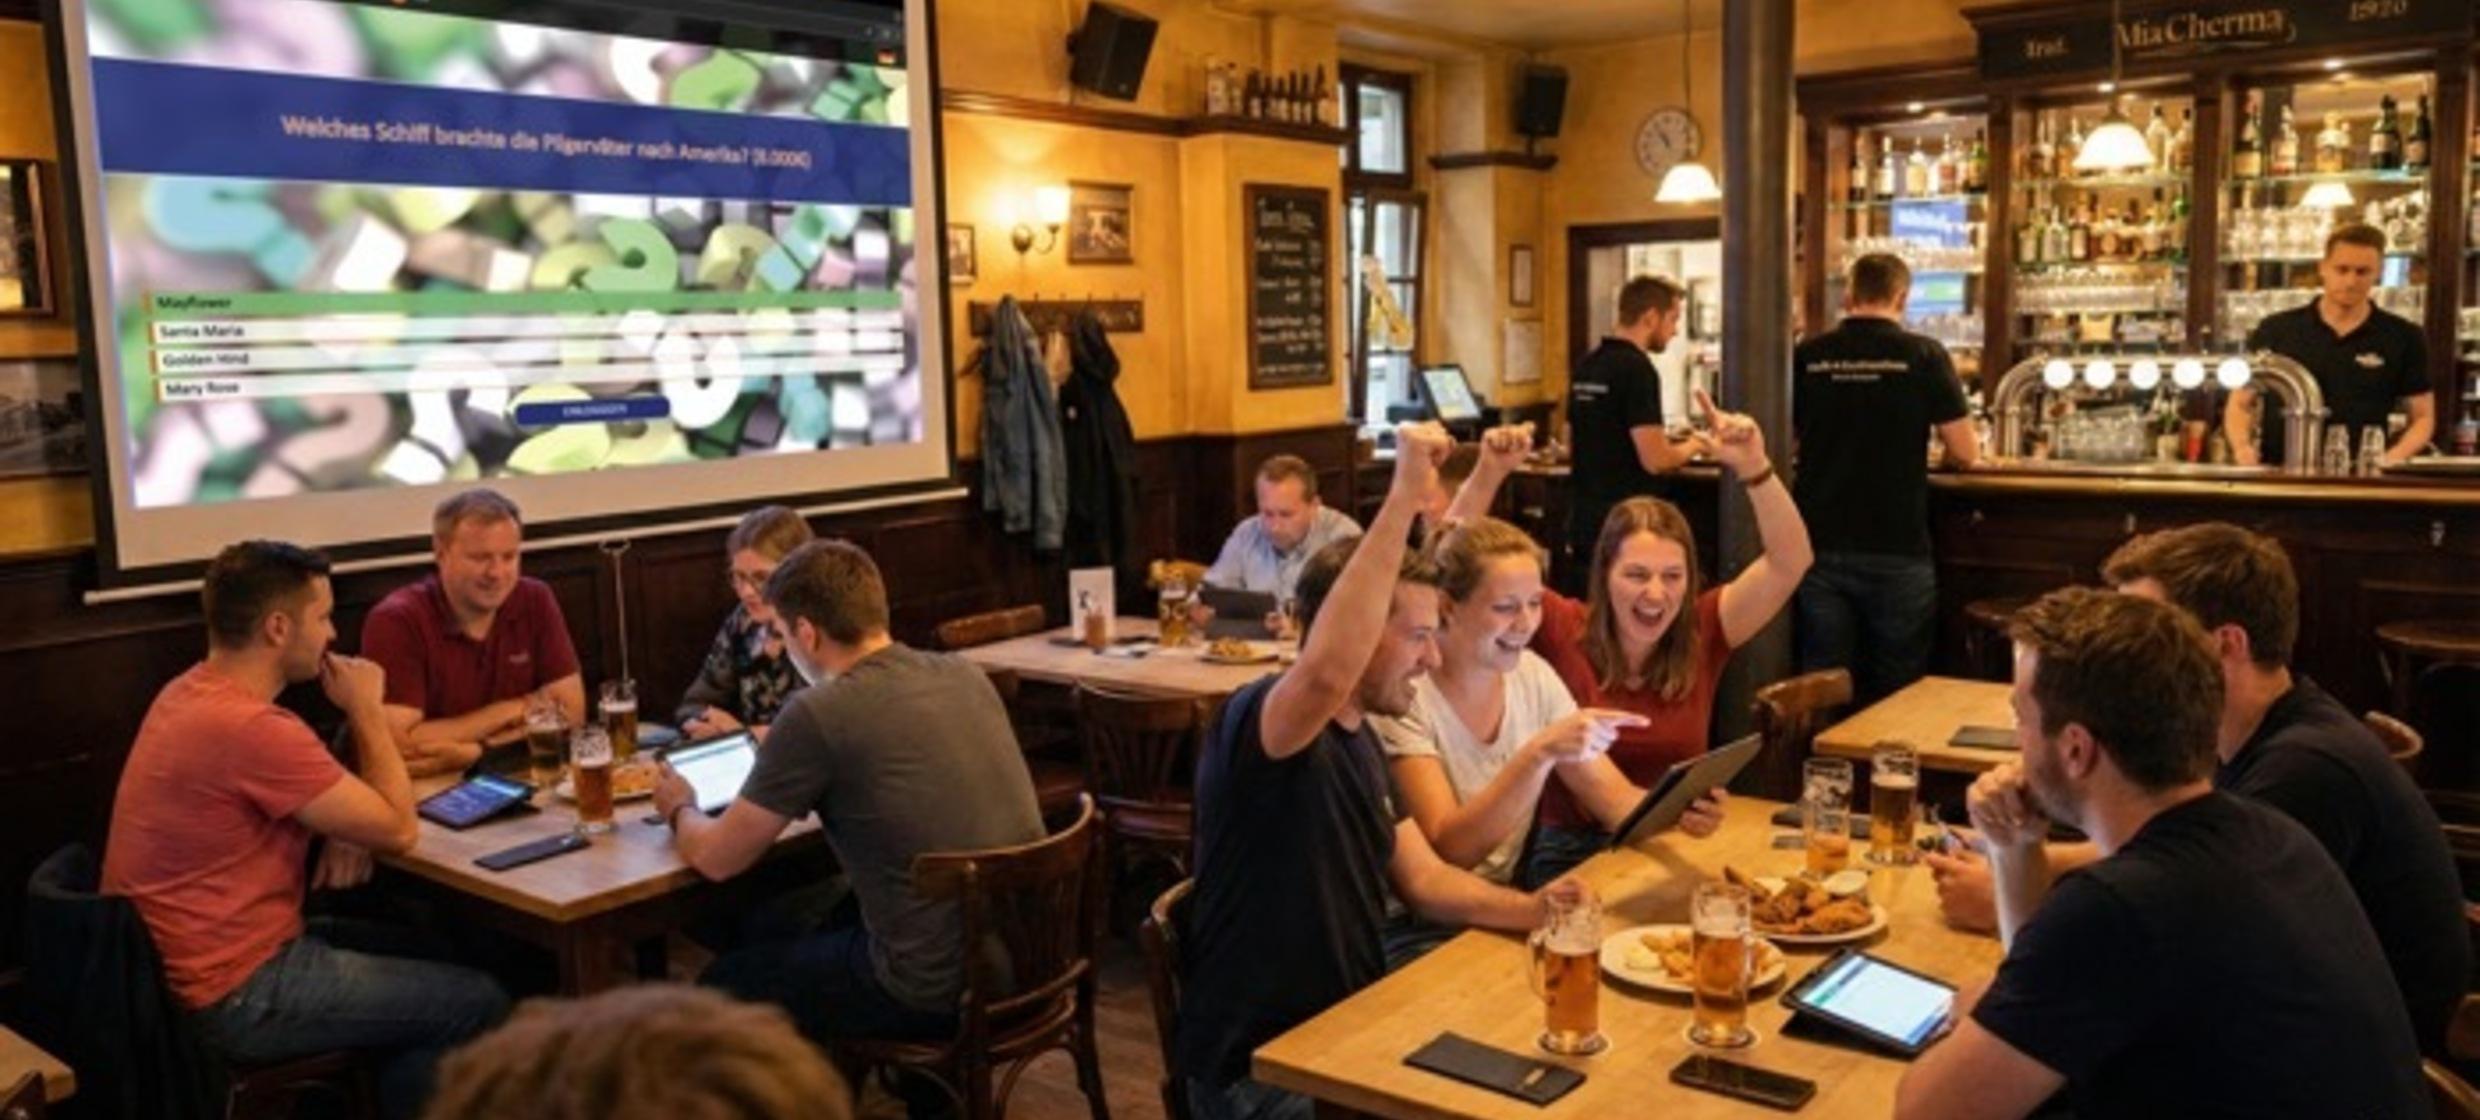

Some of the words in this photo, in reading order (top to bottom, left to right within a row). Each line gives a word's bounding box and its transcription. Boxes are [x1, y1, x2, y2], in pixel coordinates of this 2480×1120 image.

[280, 113, 370, 141] Welches
[375, 120, 430, 142] Schiff
[434, 125, 506, 148] brachte
[510, 130, 538, 150] die
[542, 133, 632, 157] Pilgerväter
[637, 140, 674, 160] nach
[679, 143, 748, 163] Amerika?
[157, 296, 232, 311] Mayflower
[160, 325, 199, 338] Santa
[203, 324, 245, 337] Maria
[162, 353, 213, 367] Golden
[216, 352, 249, 366] Hind
[165, 382, 202, 397] Mary
[206, 381, 240, 394] Rose
